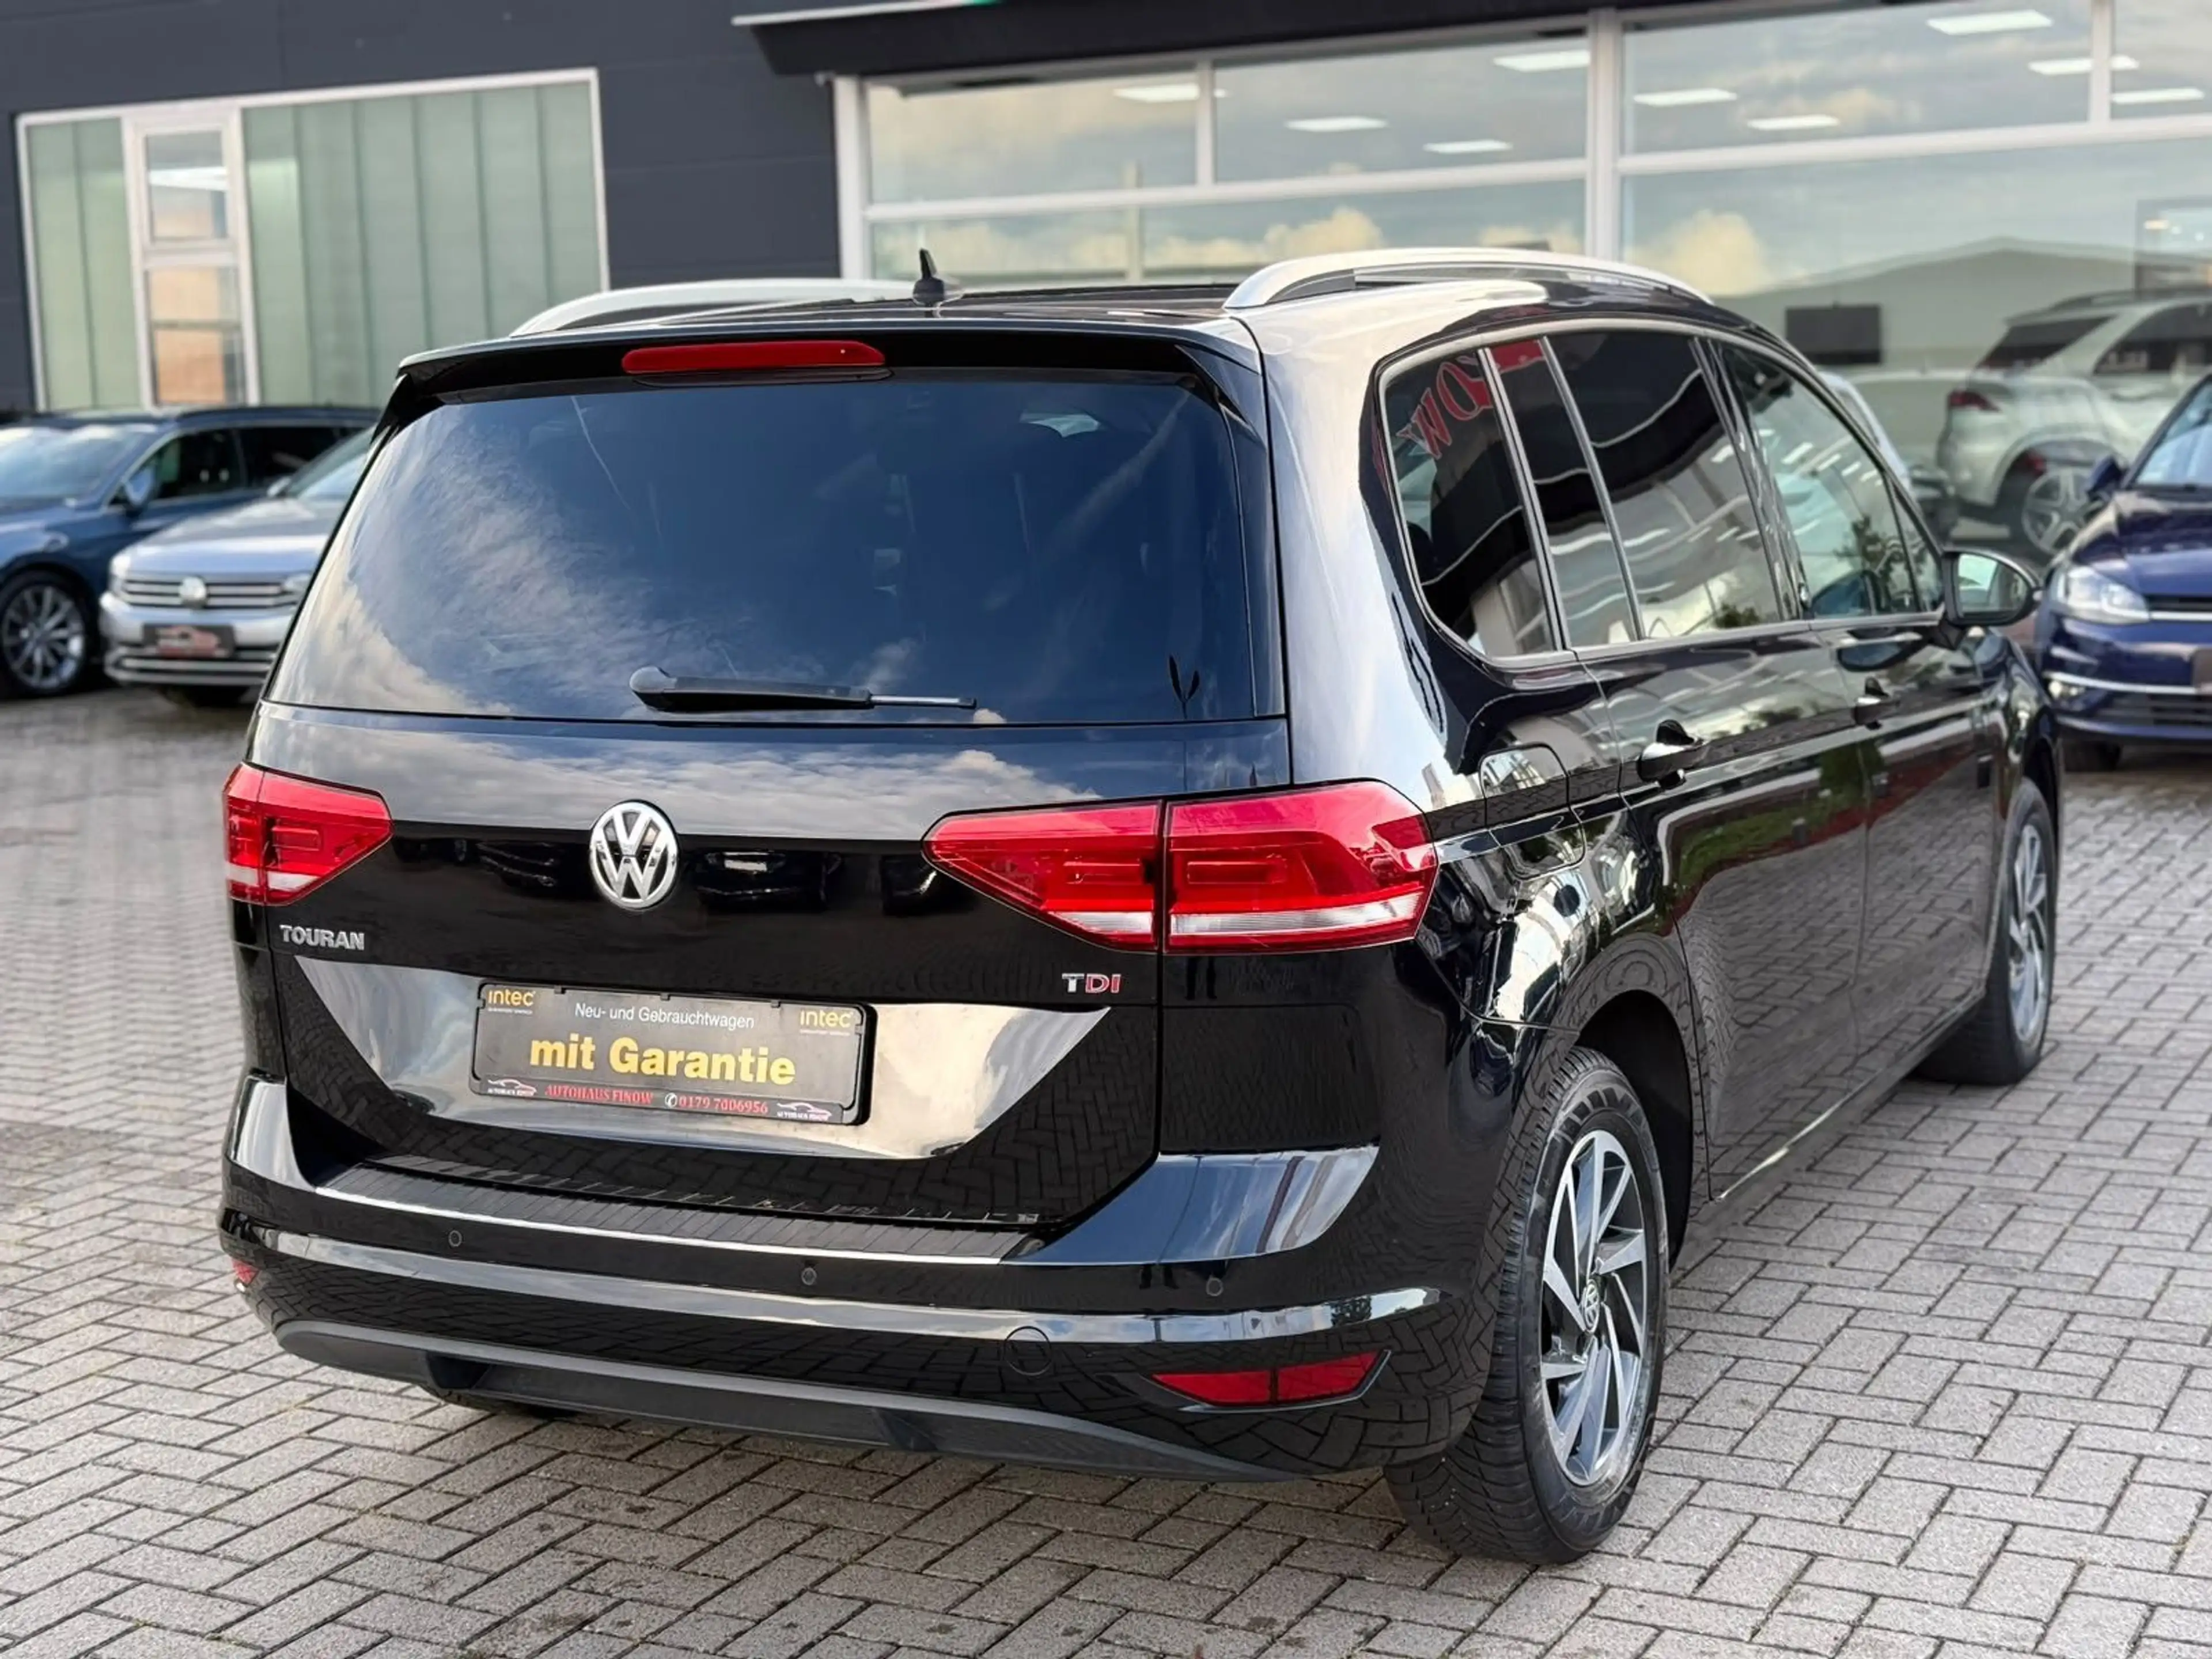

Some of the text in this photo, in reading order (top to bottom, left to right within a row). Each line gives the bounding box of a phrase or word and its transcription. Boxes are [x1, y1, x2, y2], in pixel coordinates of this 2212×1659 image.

[279, 924, 365, 950] TOURAN
[1062, 973, 1122, 993] TDI
[488, 988, 534, 1006] intec
[575, 1002, 755, 1031] Neu- und Gebrauchtwagen
[800, 1009, 851, 1028] intec
[529, 1033, 796, 1085] mit Garantie
[544, 1084, 611, 1103] AUTOHAUS
[612, 1088, 653, 1105] FINOW
[679, 1096, 710, 1109] 0179
[714, 1099, 768, 1114] 7006956
